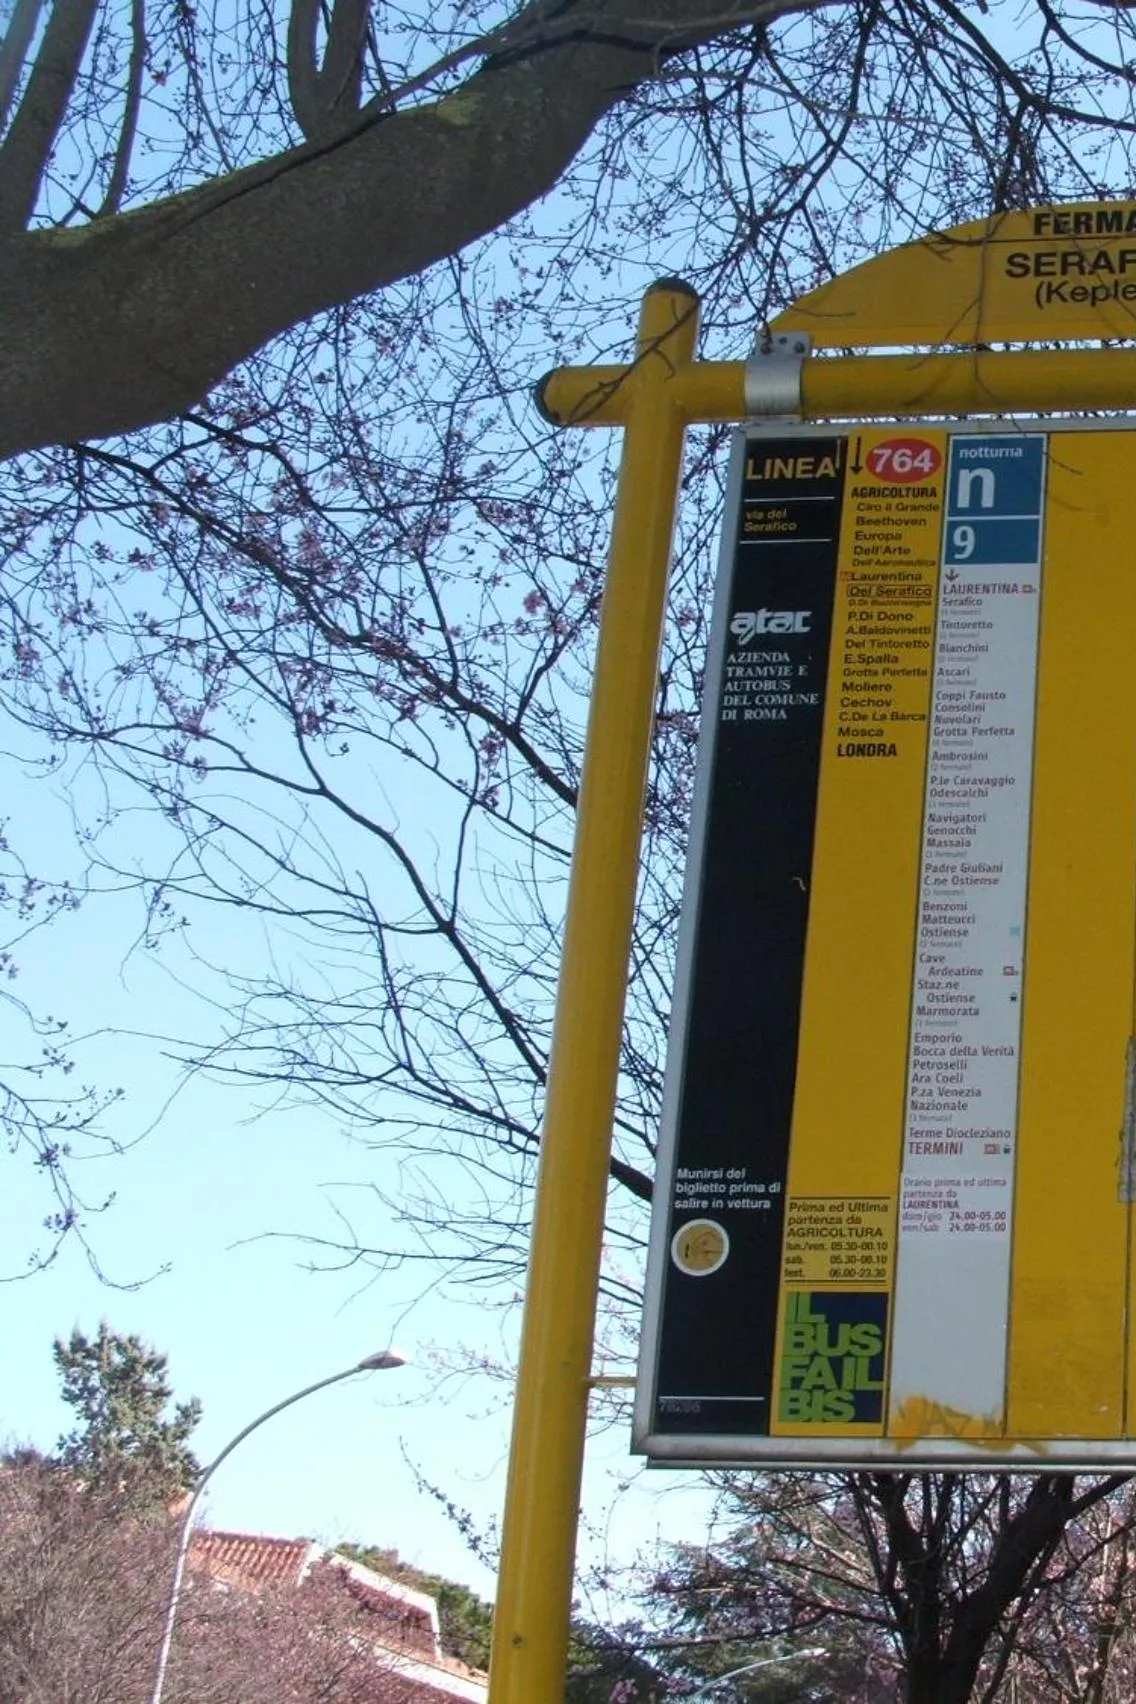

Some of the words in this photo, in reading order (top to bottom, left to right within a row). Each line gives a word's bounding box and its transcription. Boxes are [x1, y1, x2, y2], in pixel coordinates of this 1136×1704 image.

[959, 446, 1023, 458] notturna
[872, 448, 934, 474] 764
[746, 457, 836, 479] LINEA
[851, 487, 937, 498] AGRICOLTURA
[957, 467, 996, 509] n
[895, 502, 940, 511] Grande
[745, 510, 764, 519] via
[767, 508, 787, 519] del
[744, 521, 798, 532] Serafico
[856, 516, 927, 526] Beethoven
[854, 531, 902, 542] Europa
[953, 525, 976, 559] 9
[850, 571, 922, 581] Laurentina
[851, 586, 872, 597] Del
[876, 586, 932, 597] Serafico
[943, 582, 1018, 594] LAURENTINA
[942, 597, 983, 606] Serafico
[876, 611, 913, 621] Dono
[730, 608, 812, 645] atac
[941, 620, 993, 629] Tintoretto
[845, 639, 865, 649] Del
[869, 639, 930, 649] Tintoretto
[939, 643, 988, 653] Bianchini
[727, 652, 790, 663] AZIENDA
[843, 653, 899, 665] E.Spalla
[726, 665, 793, 677] TRAMVIE
[798, 665, 808, 676] E
[843, 667, 878, 676] Grotta
[937, 667, 970, 676] Ascari
[725, 680, 791, 692] AUTOBUS
[723, 695, 752, 706] DEL
[754, 693, 819, 705] COMUNE
[936, 690, 966, 701] Coppi
[968, 690, 1006, 700] Fausto
[840, 697, 892, 708] Cechov
[935, 703, 985, 712] Consolini
[722, 709, 737, 720] DI
[744, 708, 787, 720] ROMA
[872, 711, 887, 721] La
[890, 711, 926, 721] Barca
[838, 727, 884, 737] Mosca
[934, 727, 967, 736] Grotta
[971, 726, 1016, 736] Perfetta
[837, 743, 898, 757] LONDRA
[932, 751, 988, 761] Ambrosini
[953, 775, 1016, 787] Caravaggio
[930, 788, 989, 798] Odescalchi
[928, 813, 986, 824] Navigatori
[927, 825, 977, 835] Genocchi
[925, 863, 957, 873] Padre
[950, 875, 1000, 885] Ostiense
[923, 901, 968, 911] Benzoni
[922, 914, 976, 924] Matteucci
[921, 926, 969, 937] Ostiense
[920, 953, 946, 963] Cave
[928, 966, 984, 976] Ardeatine
[926, 992, 976, 1003] Ostiense
[916, 1006, 980, 1016] Marmorata
[914, 1032, 962, 1044] Emporio
[913, 1045, 946, 1056] Bocca
[949, 1045, 978, 1056] della
[912, 1059, 967, 1070] Petroselli
[911, 1072, 931, 1083] Ara
[935, 1072, 964, 1083] Coeli
[937, 1086, 983, 1097] Venezia
[910, 1099, 969, 1111] Nazionale
[909, 1127, 942, 1138] Terme
[946, 1127, 1011, 1138] Diocleziano
[908, 1142, 963, 1154] TERMINI
[676, 1168, 723, 1179] Munirsi
[726, 1168, 746, 1179] del
[675, 1182, 726, 1195] biglietto
[729, 1182, 766, 1195] prima
[768, 1181, 781, 1192] di
[674, 1199, 709, 1208] salire
[711, 1198, 724, 1208] in
[727, 1198, 771, 1208] vettura
[789, 1202, 825, 1212] Prima
[828, 1202, 845, 1212] ed
[847, 1202, 889, 1212] Ultima
[903, 1200, 960, 1209] LAURENTINA
[788, 1215, 844, 1226] partenza
[846, 1215, 862, 1224] da
[787, 1227, 884, 1238] AGRICOLTURA
[782, 1323, 883, 1357] BUS
[777, 1389, 856, 1423] BIS
